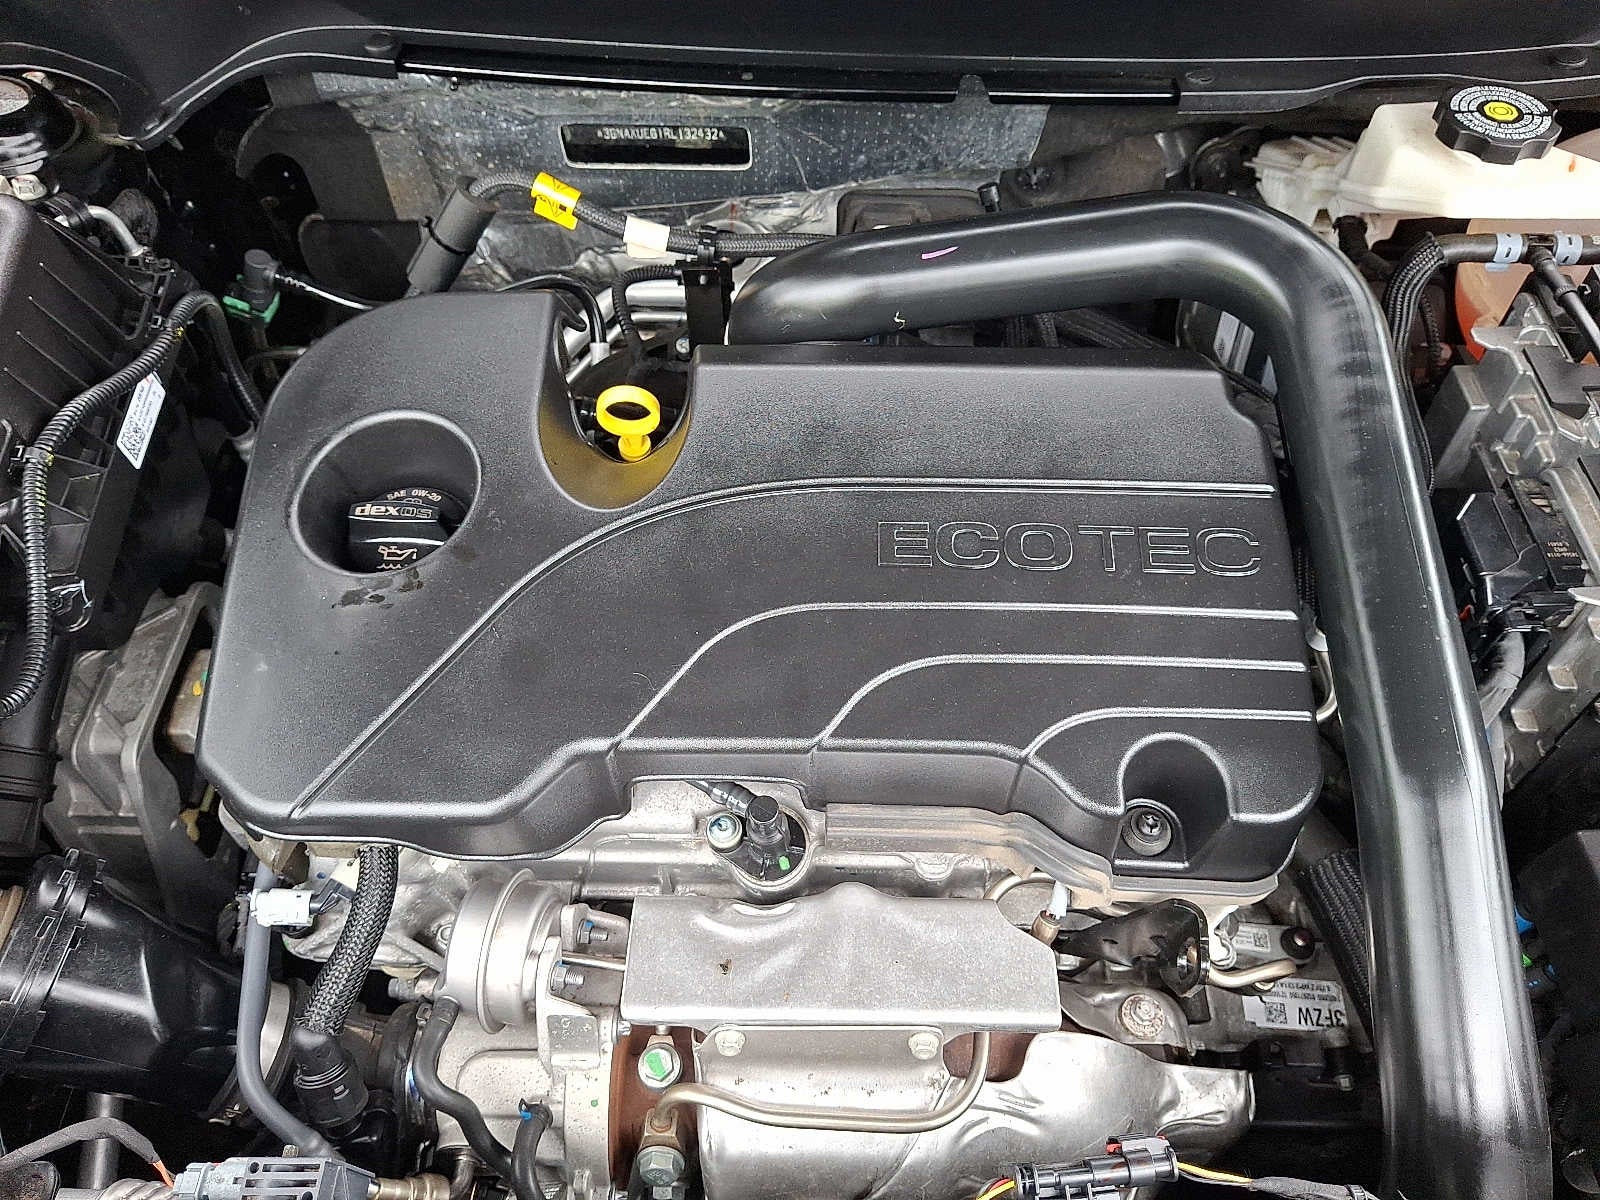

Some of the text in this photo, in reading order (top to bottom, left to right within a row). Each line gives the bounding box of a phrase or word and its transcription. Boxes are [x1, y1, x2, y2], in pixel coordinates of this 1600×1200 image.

[386, 489, 442, 502] SAE 0W-20
[354, 503, 433, 519] dexos
[876, 521, 1263, 577] ECOTEC
[1298, 1006, 1345, 1028] 3FZW
